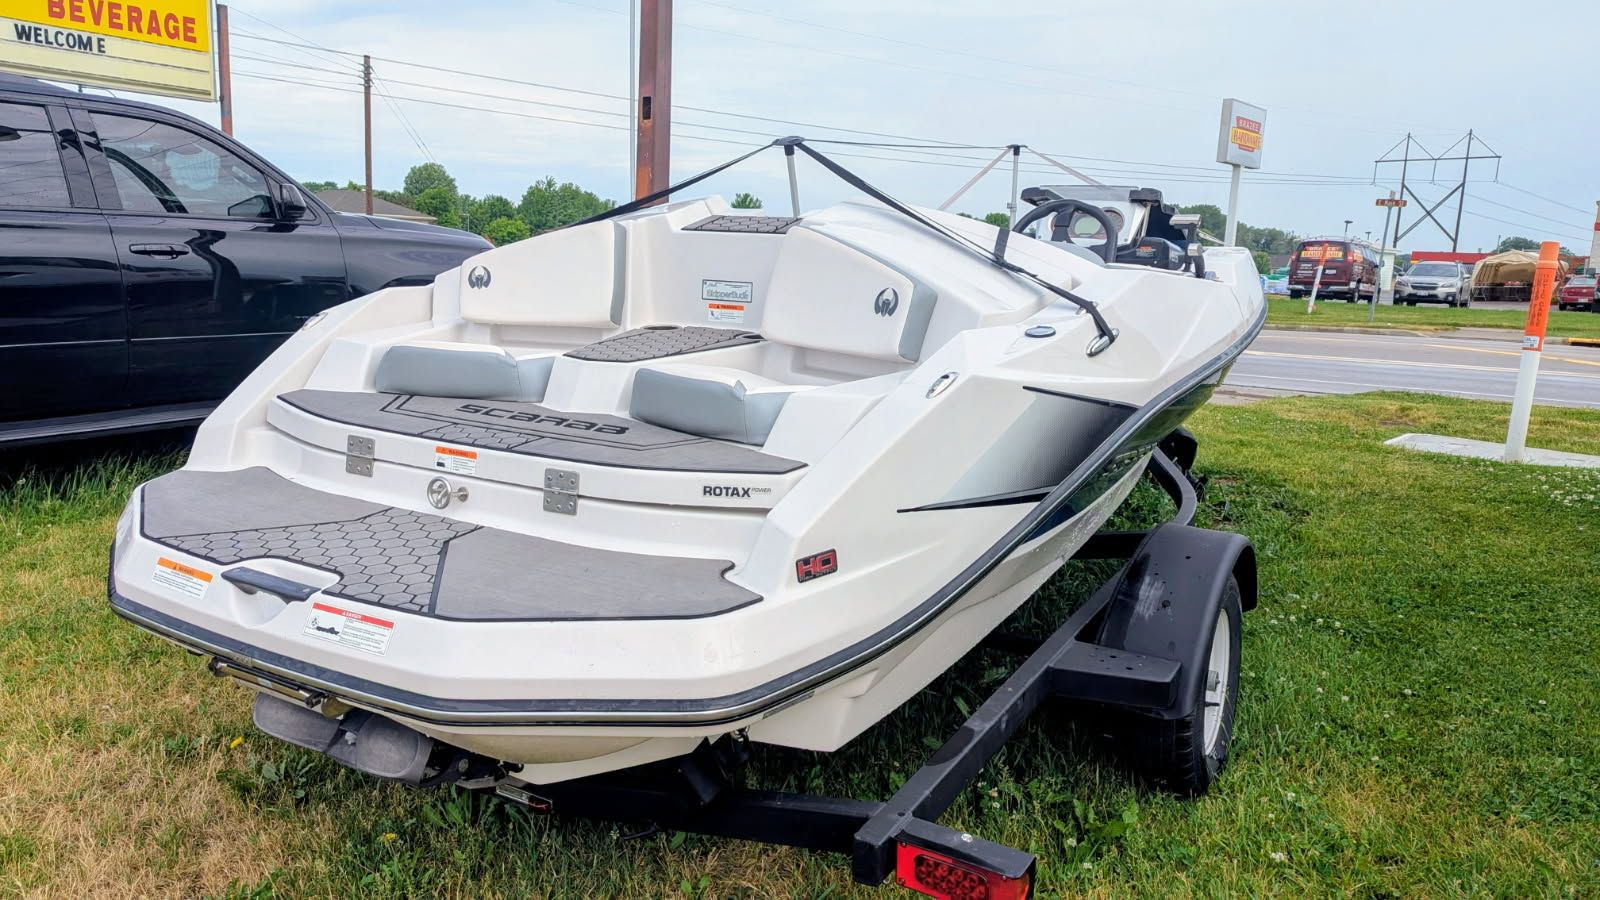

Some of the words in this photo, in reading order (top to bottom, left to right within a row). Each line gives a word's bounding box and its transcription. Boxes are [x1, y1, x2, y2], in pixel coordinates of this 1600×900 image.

[47, 0, 197, 43] BEVERAGE
[14, 23, 106, 53] WELCOME
[456, 403, 630, 435] SCARAB
[703, 485, 751, 498] ROTAX
